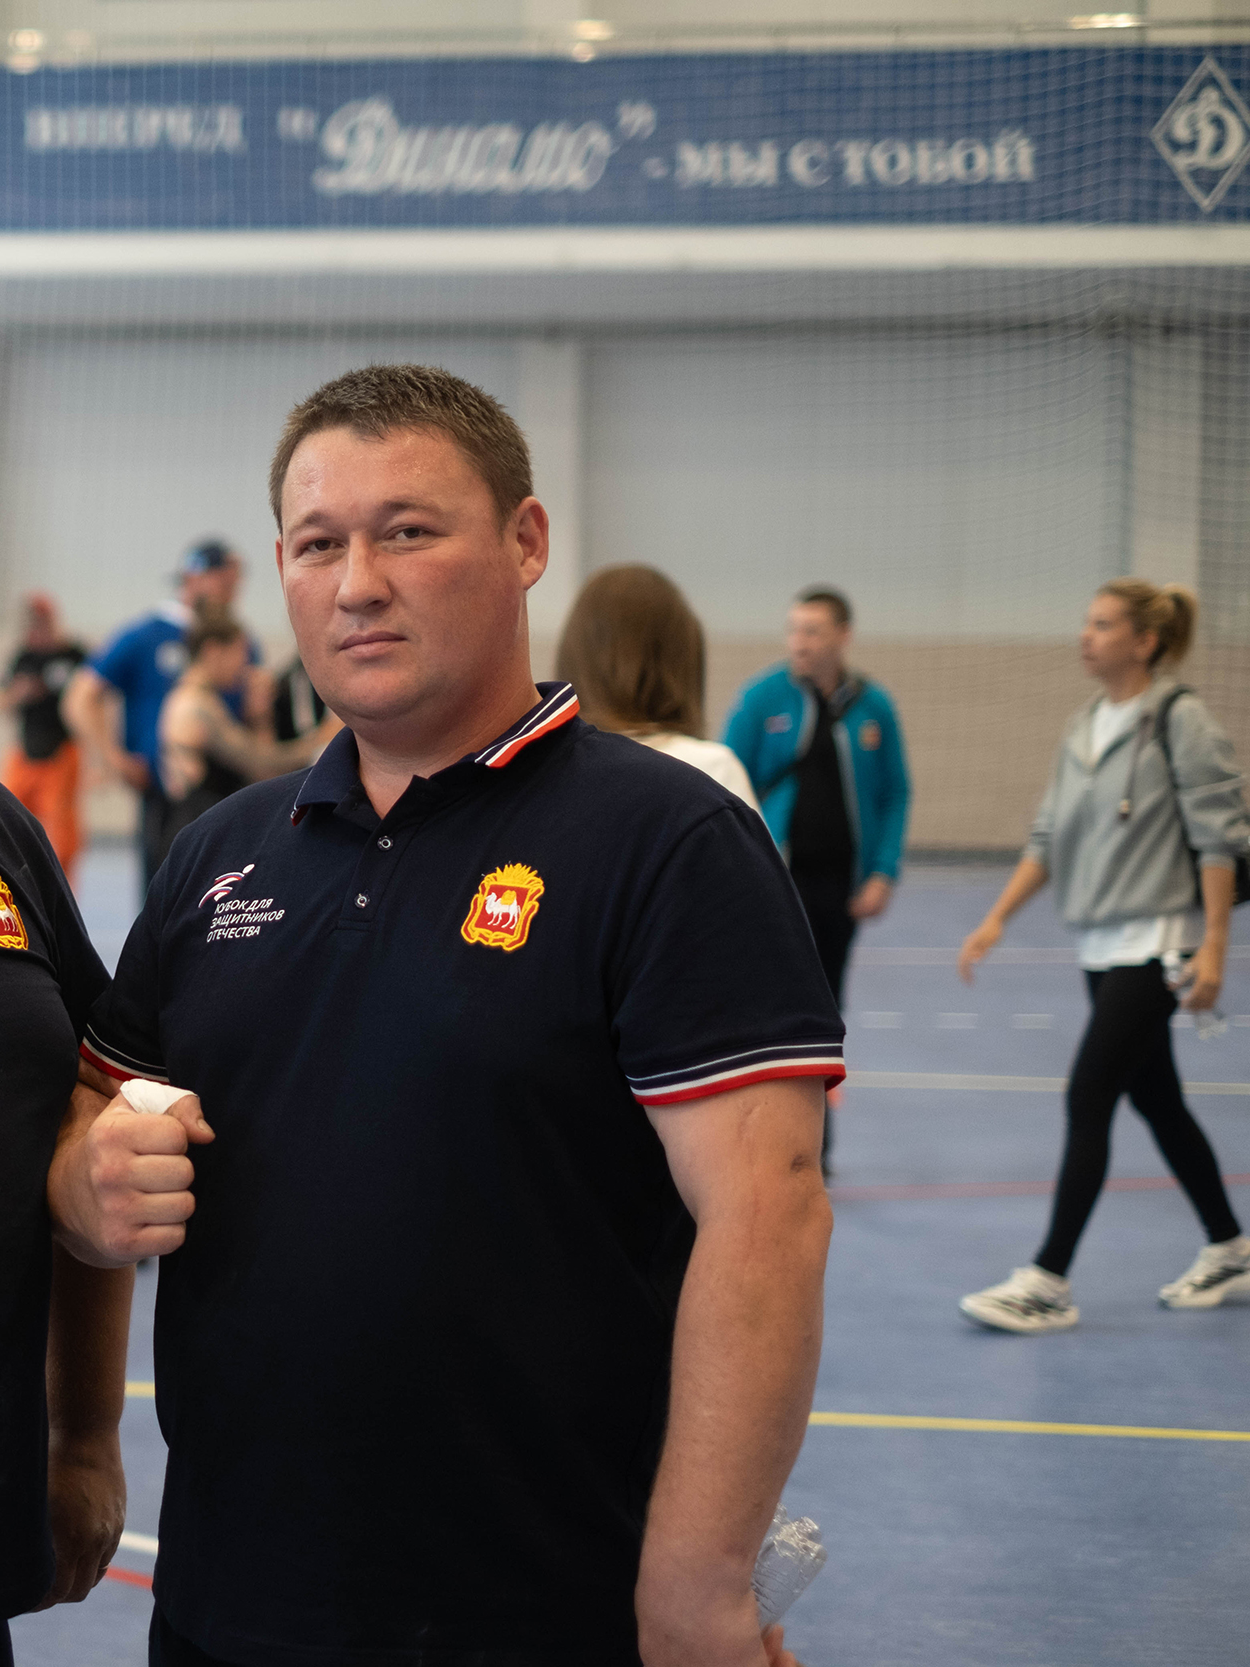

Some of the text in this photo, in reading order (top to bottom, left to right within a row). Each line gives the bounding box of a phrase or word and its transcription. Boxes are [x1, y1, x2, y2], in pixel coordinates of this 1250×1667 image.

[675, 139, 779, 188] МЫ
[786, 138, 831, 187] С
[837, 128, 1036, 185] ТОБОЙ
[214, 898, 274, 914] КУБОК ДЛЯ
[210, 909, 285, 929] ЗАЩИТНИКОВ
[206, 926, 261, 943] ОТЕЧЕСТВА
